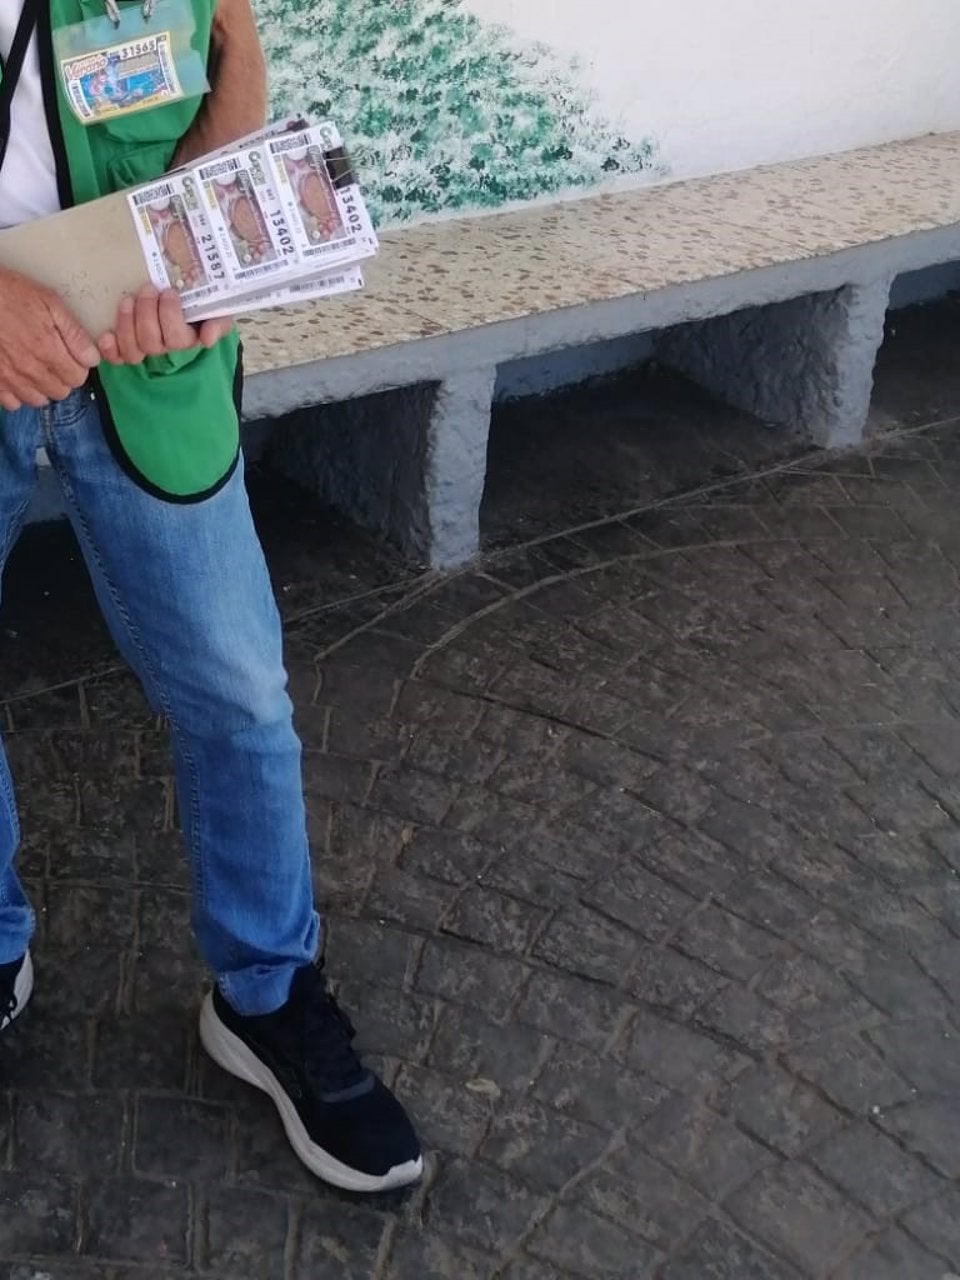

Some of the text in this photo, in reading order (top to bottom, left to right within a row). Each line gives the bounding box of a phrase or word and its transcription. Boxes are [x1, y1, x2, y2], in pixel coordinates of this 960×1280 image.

[122, 38, 156, 59] 31565
[268, 207, 295, 255] 13402
[339, 186, 363, 234] 13402
[200, 233, 226, 280] 21587
